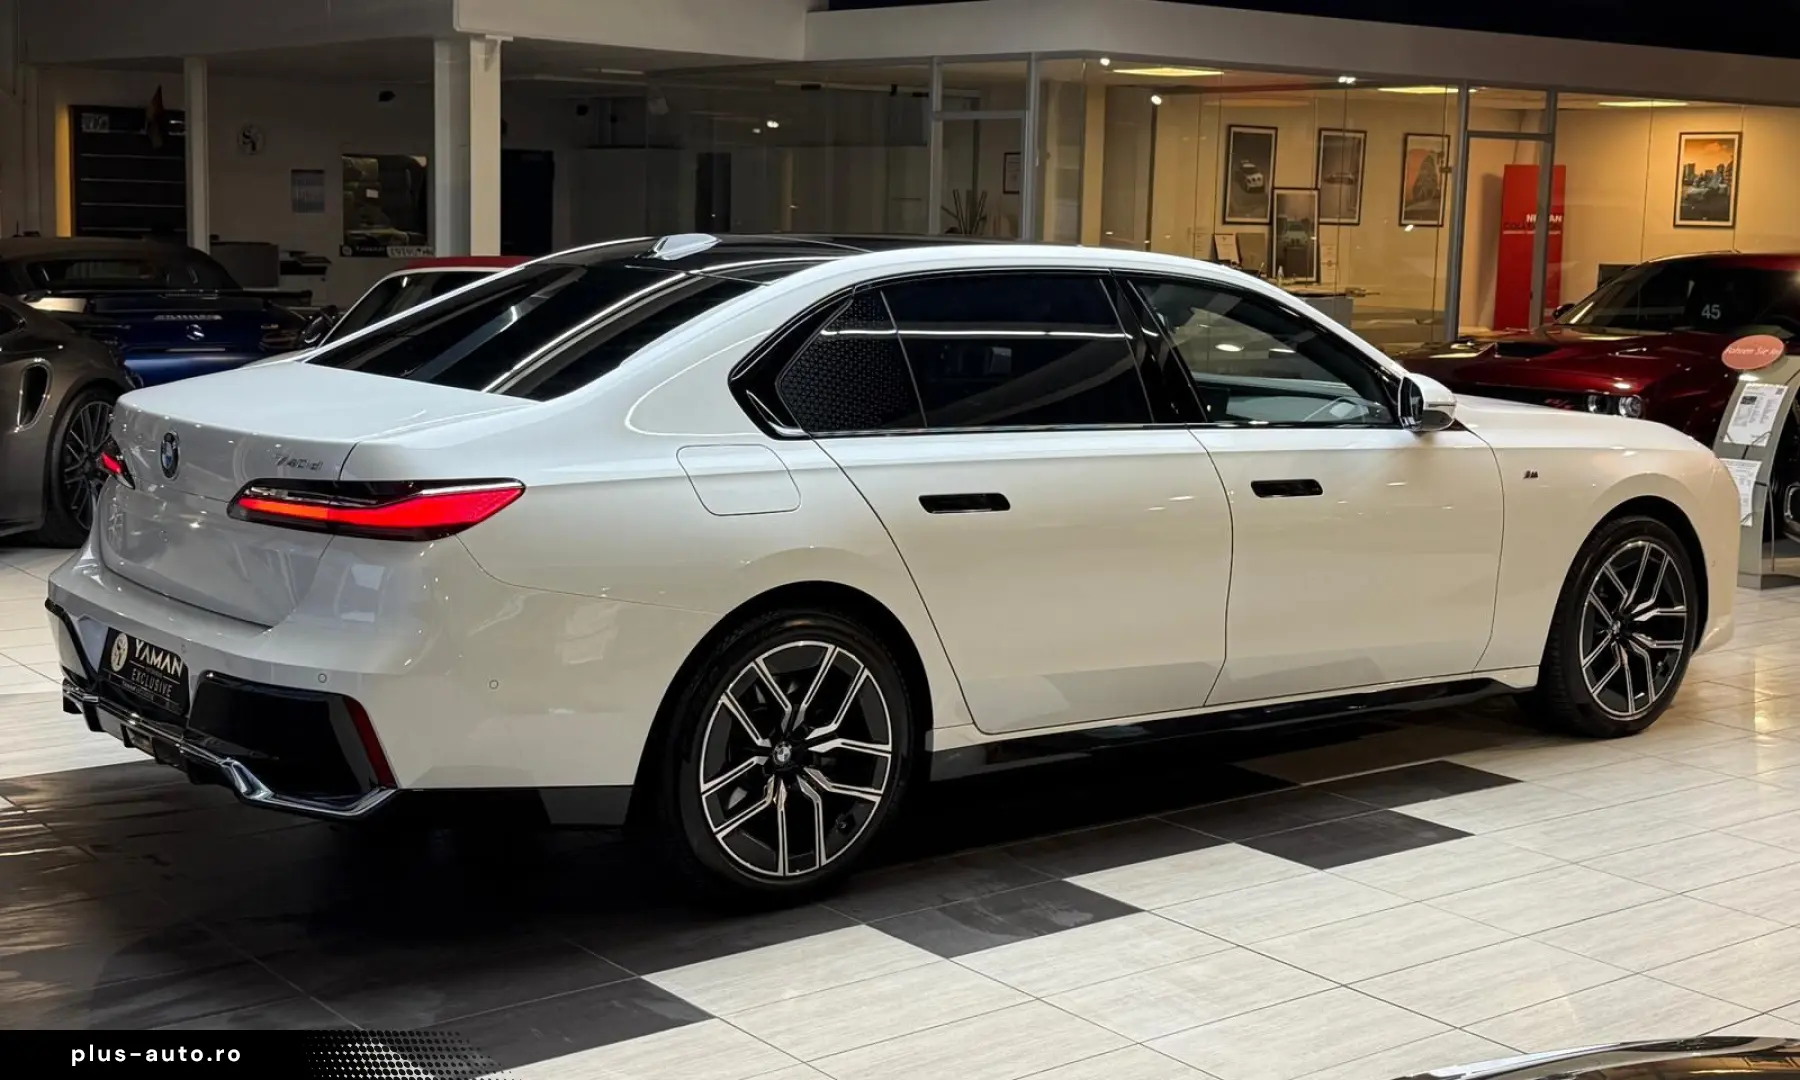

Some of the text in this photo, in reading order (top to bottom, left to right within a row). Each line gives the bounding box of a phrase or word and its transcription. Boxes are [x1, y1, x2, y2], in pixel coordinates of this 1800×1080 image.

[1701, 304, 1721, 319] 45
[135, 639, 184, 677] YAMAN
[131, 668, 173, 698] EXCLUSIVE
